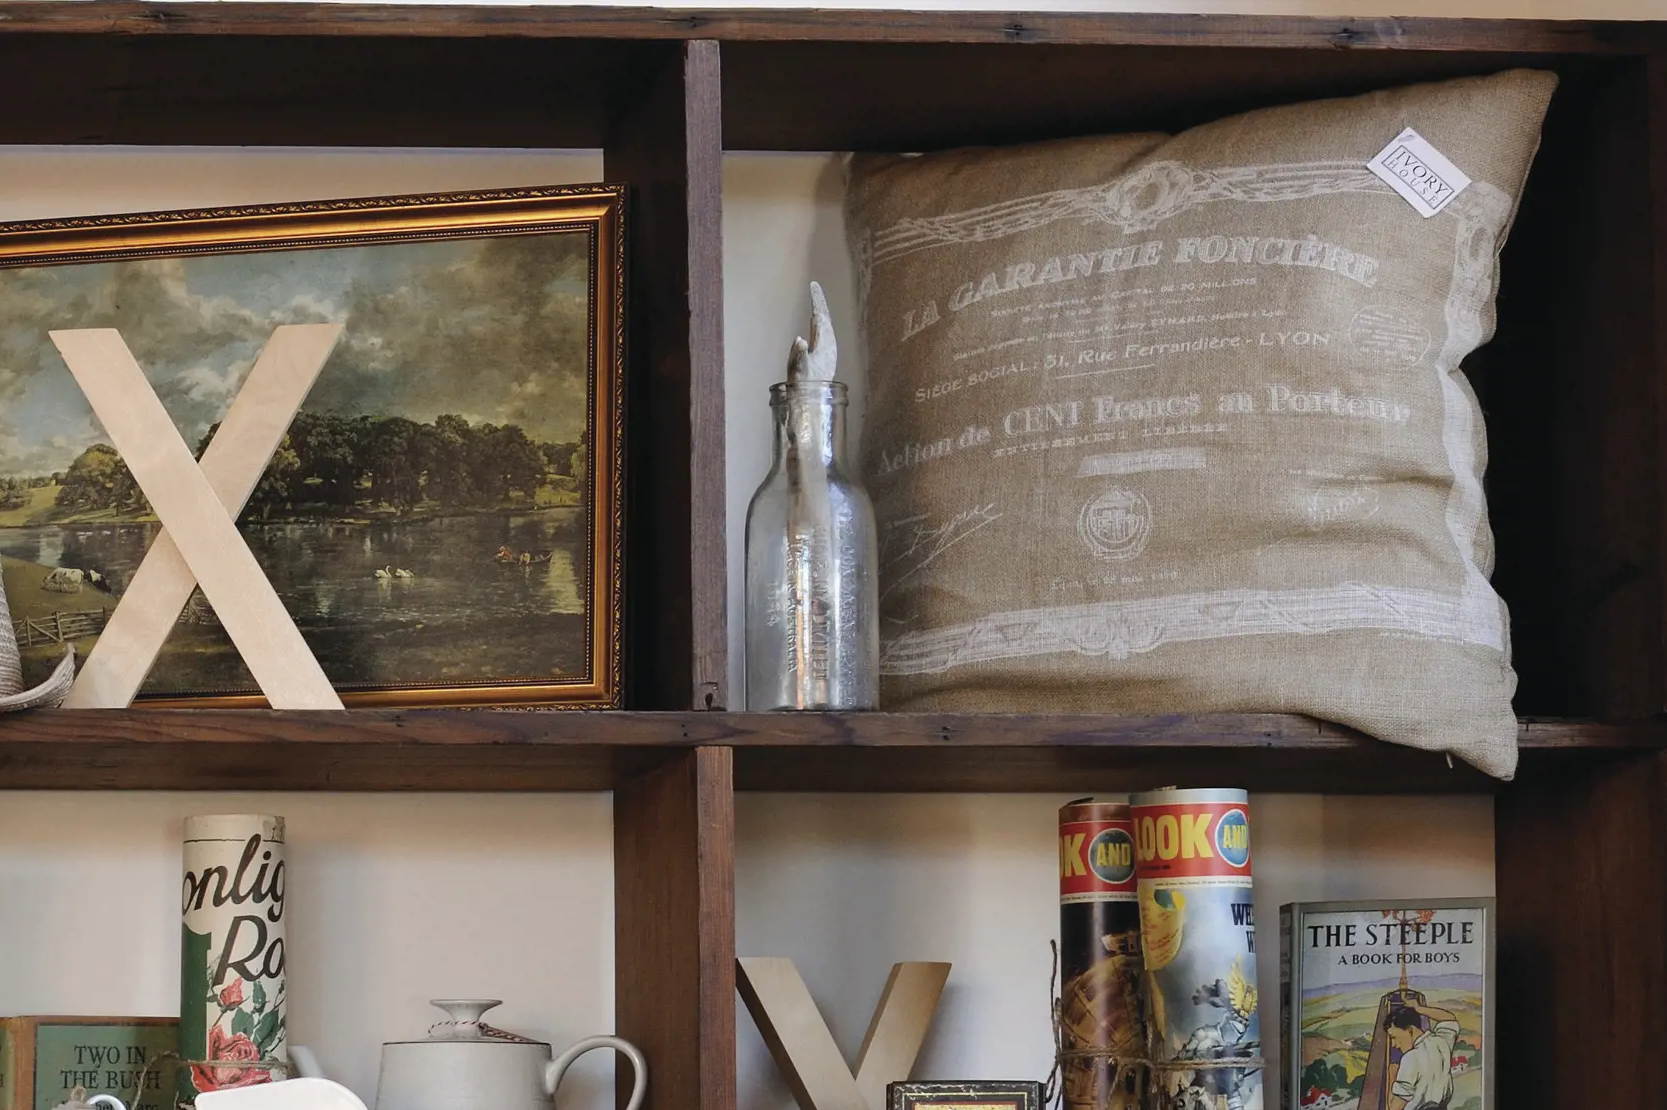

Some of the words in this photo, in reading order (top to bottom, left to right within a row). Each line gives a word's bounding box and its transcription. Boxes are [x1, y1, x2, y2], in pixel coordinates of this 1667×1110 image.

[1387, 159, 1438, 205] HOUSE
[1396, 151, 1449, 194] IVORY
[948, 240, 1162, 312] GARANTIE
[1077, 348, 1117, 364] Rue
[1259, 332, 1331, 348] LYON
[958, 423, 991, 448] de
[1003, 400, 1083, 439] CENT
[1090, 391, 1202, 424] Francs
[1219, 391, 1255, 413] au
[1265, 384, 1412, 424] Porteur
[49, 323, 344, 711] X
[1222, 824, 1248, 849] AND
[1096, 842, 1132, 867] AND
[1307, 924, 1356, 947] THE
[1365, 921, 1474, 946] STEEPLE
[1337, 955, 1348, 965] A
[1352, 953, 1393, 965] BOOK
[1396, 952, 1422, 964] FOR
[1425, 952, 1460, 964] BOYS
[74, 1045, 120, 1065] TWO
[126, 1046, 147, 1064] IN
[60, 1070, 99, 1089] THE
[105, 1070, 162, 1089] BUSH
